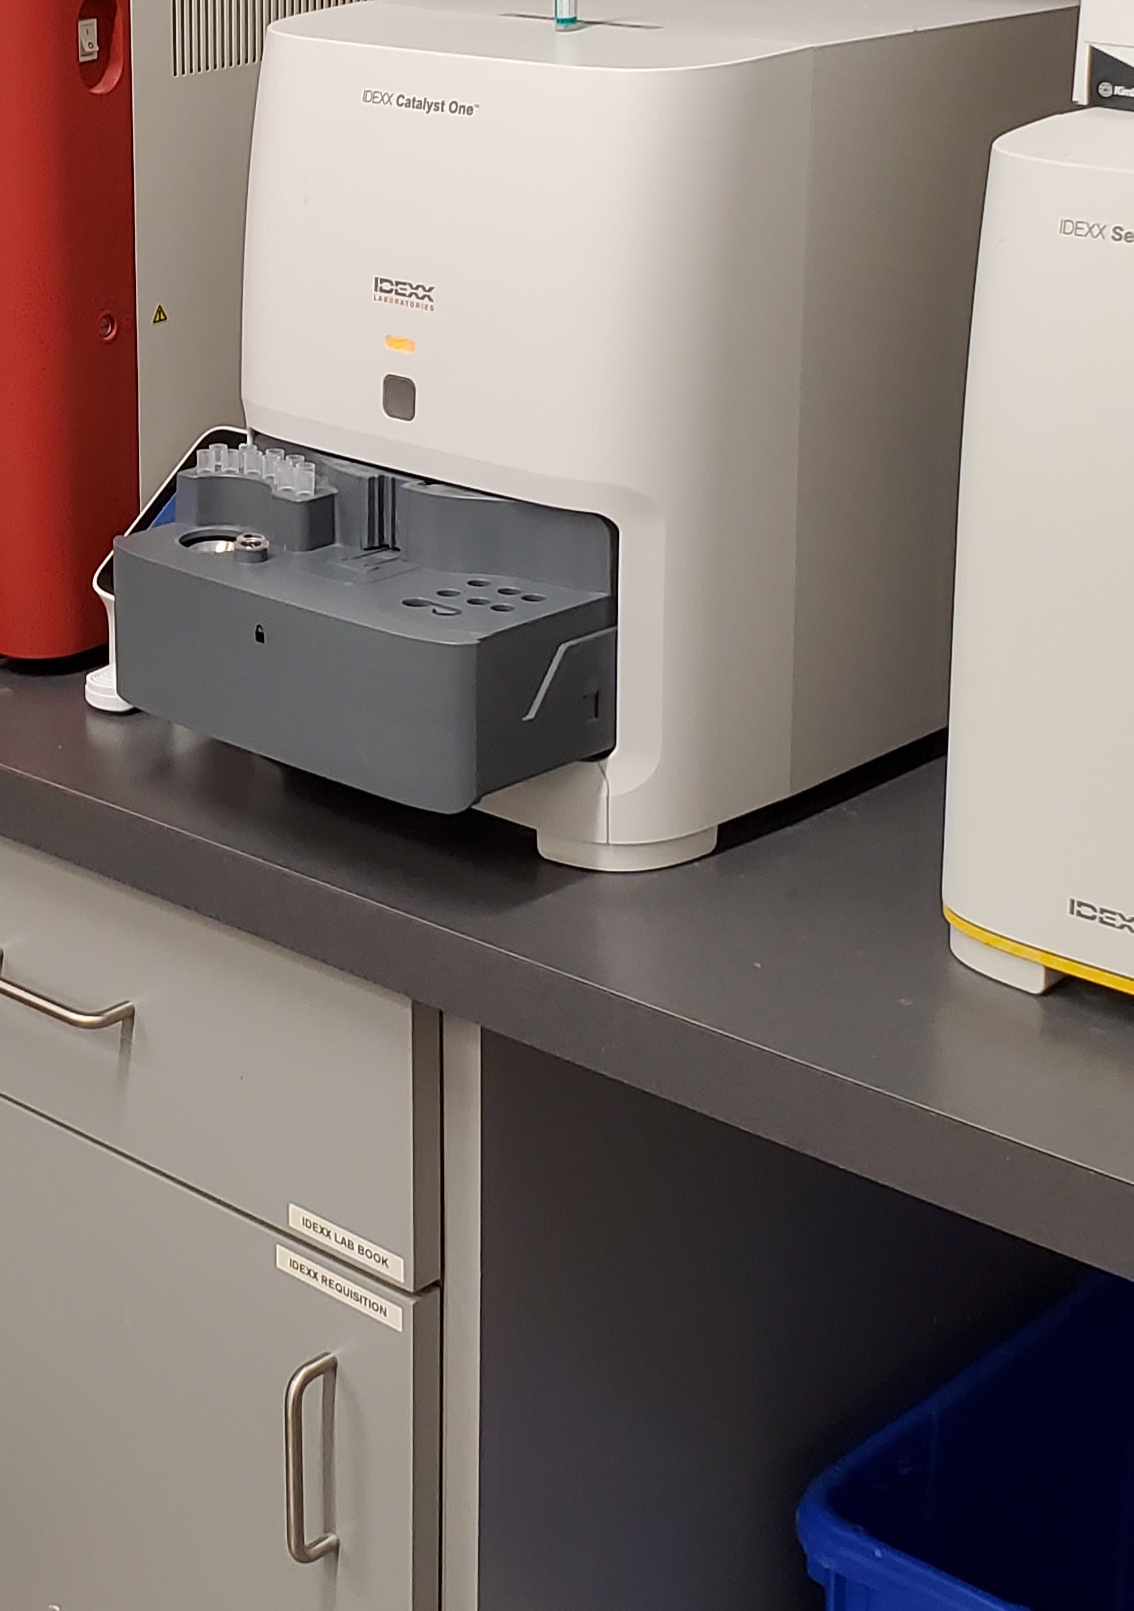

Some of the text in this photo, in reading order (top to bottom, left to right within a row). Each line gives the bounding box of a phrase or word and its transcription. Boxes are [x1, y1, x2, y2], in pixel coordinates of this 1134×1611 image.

[363, 89, 394, 105] IDEXX
[396, 93, 446, 114] Catalyst
[1059, 219, 1107, 240] IDEXX
[374, 277, 435, 303] IDEXX
[374, 293, 434, 311] LABORATORIES
[302, 1215, 390, 1269] IDEXX LAB BOOK
[289, 1257, 388, 1317] IDEXX REQUISITION
